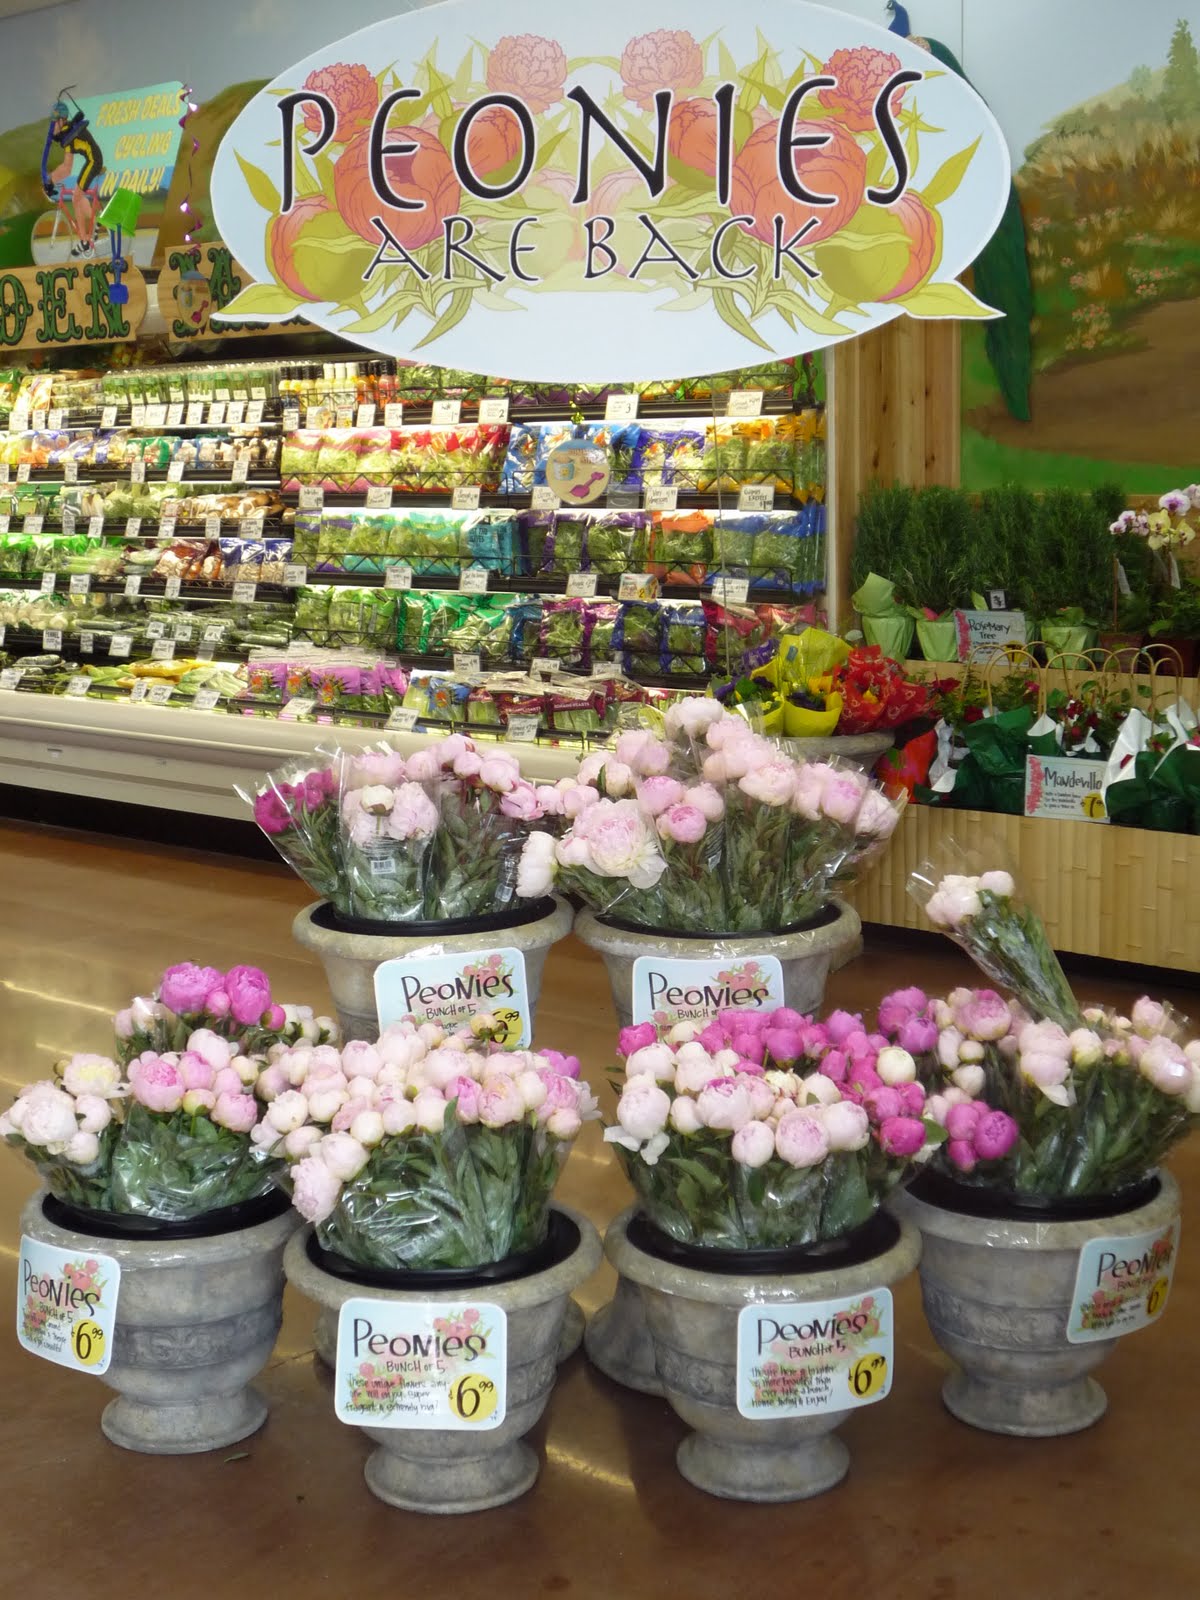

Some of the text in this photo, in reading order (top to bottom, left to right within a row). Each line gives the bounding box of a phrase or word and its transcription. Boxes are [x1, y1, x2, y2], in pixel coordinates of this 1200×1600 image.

[96, 89, 185, 128] FRESH DEALS
[114, 130, 173, 161] CYCLING
[277, 69, 926, 212] PEONIES
[100, 166, 165, 198] IN DAILY!
[361, 214, 822, 283] ARE BACK
[426, 1005, 457, 1019] BUNCH
[467, 1003, 477, 1016] 5
[677, 1009, 709, 1019] BUNCH
[386, 1360, 421, 1373] BUNCH
[436, 1360, 446, 1374] 5
